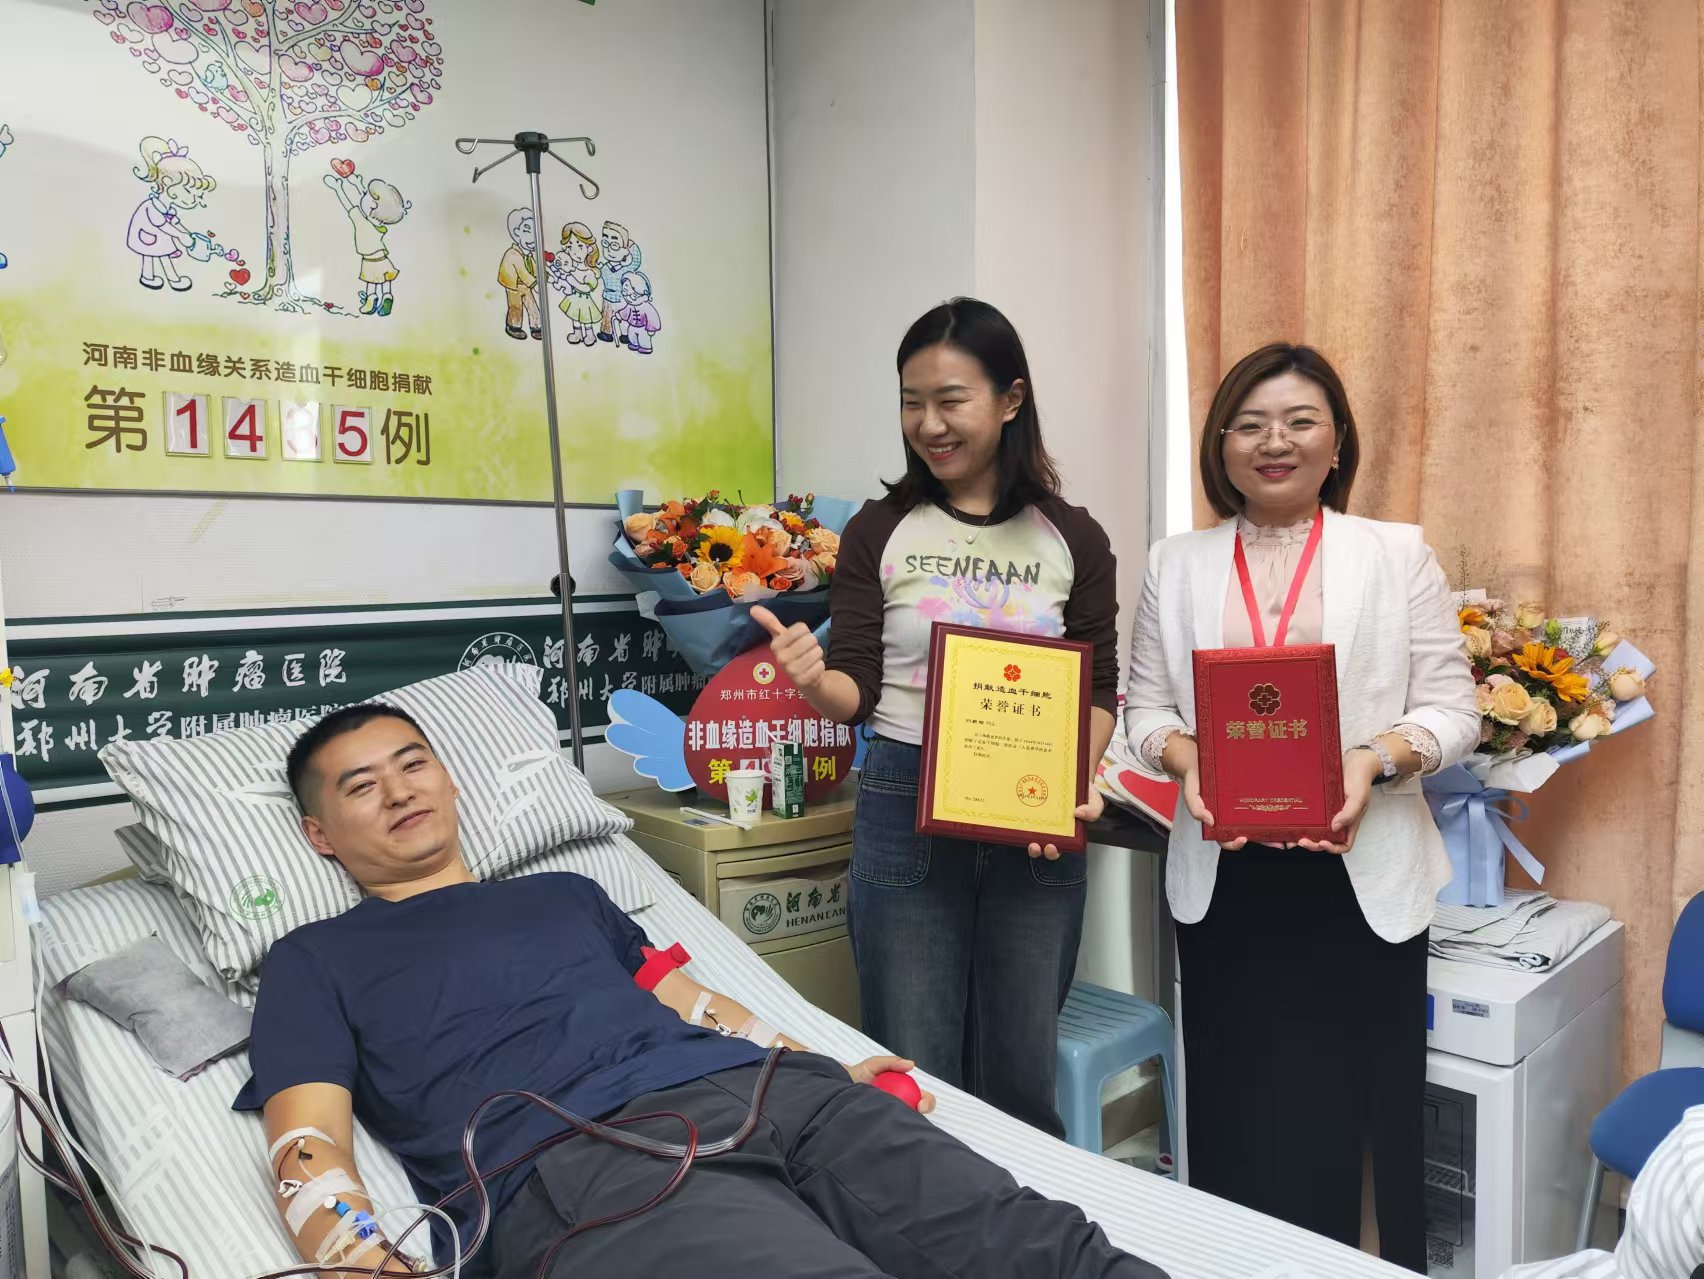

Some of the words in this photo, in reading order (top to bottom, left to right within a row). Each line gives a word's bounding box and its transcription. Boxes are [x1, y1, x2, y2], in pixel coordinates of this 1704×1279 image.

[82, 342, 433, 396] 河南非血缘关系造血干细胞捐献
[905, 554, 1041, 585] SEENFAAN
[543, 628, 678, 668] 河南省肿
[10, 648, 348, 710] 河南省肿瘤医院
[546, 671, 714, 709] 郑州大学附属肿瘤
[972, 682, 1052, 700] 捐献造血干细胞
[980, 698, 1042, 717] 荣誉证书
[688, 718, 852, 751] 非血缘造血干细胞捐献
[1226, 718, 1308, 740] 荣誉证书
[786, 883, 842, 914] 河南省
[786, 911, 824, 928] HENAN
